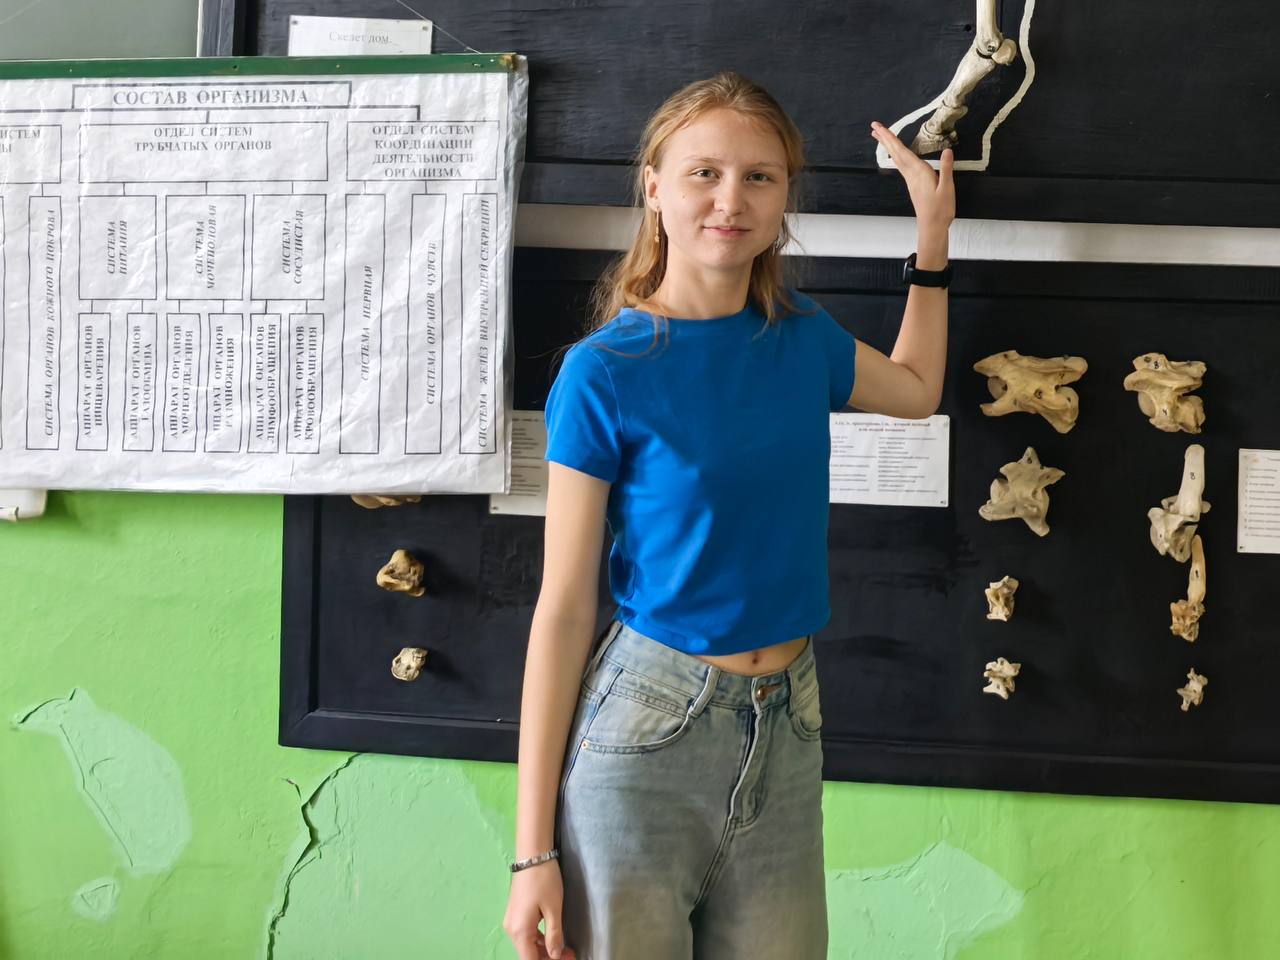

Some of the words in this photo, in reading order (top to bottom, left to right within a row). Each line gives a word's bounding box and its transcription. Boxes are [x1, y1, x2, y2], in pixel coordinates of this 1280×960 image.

[113, 90, 187, 105] СОСТАВ
[196, 89, 308, 105] ОРГАНИЗМА
[135, 141, 208, 152] ТРУБЧАТЫХ
[214, 140, 272, 151] ОРГАНОВ
[154, 127, 194, 138] ОТДЕЛ
[200, 126, 252, 138] СИСТЕМ
[372, 125, 418, 136] ОТДЕЛ
[420, 124, 475, 136] СИСТЕМ
[375, 139, 473, 150] КООРДИНАЦИИ
[384, 167, 462, 178] ОРГАНИЗМА
[46, 209, 55, 262] ПОКРОВА
[107, 221, 116, 275] СИСТЕМА
[119, 220, 128, 275] ПИТАНИЯ
[195, 221, 204, 275] СИСТЕМА
[282, 221, 291, 274] СИСТЕМА
[480, 199, 490, 261] СЕКРЕЦИИ
[426, 242, 438, 286] ЧУВСТВ
[45, 266, 55, 322] КОЖНОГО
[362, 265, 373, 319] НЕРВНАЯ
[426, 292, 436, 345] ОРГАНОВ
[479, 263, 489, 341] ВНУТРЕННЕЙ
[45, 326, 54, 378] ОРГАНОВ
[84, 325, 93, 378] ОРГАНОВ
[132, 325, 141, 378] ОРГАНОВ
[172, 325, 181, 379] ОРГАНОВ
[215, 325, 224, 380] ОРГАНОВ
[255, 326, 265, 381] ОРГАНОВ
[295, 326, 305, 380] ОРГАНОВ
[361, 327, 370, 381] СИСТЕМА
[427, 350, 436, 405] СИСТЕМА
[479, 346, 489, 384] ЖЕЛЕЗ
[94, 338, 104, 426] ПИЩЕВАРЕНИЯ
[267, 324, 277, 443] ЛИМФООБРАЩЕНИЯ
[305, 327, 318, 440] КРОВООБРАЩЕНИЯ
[45, 384, 53, 436] СИСТЕМА
[83, 384, 92, 437] АППАРАТ
[130, 384, 140, 437] АППАРАТ
[169, 386, 179, 439] АППАРАТ
[213, 387, 222, 431] ППАРАТ
[255, 387, 264, 440] АППАРАТ
[294, 387, 304, 440] АППАРАТ
[478, 393, 488, 448] СИСТЕМА
